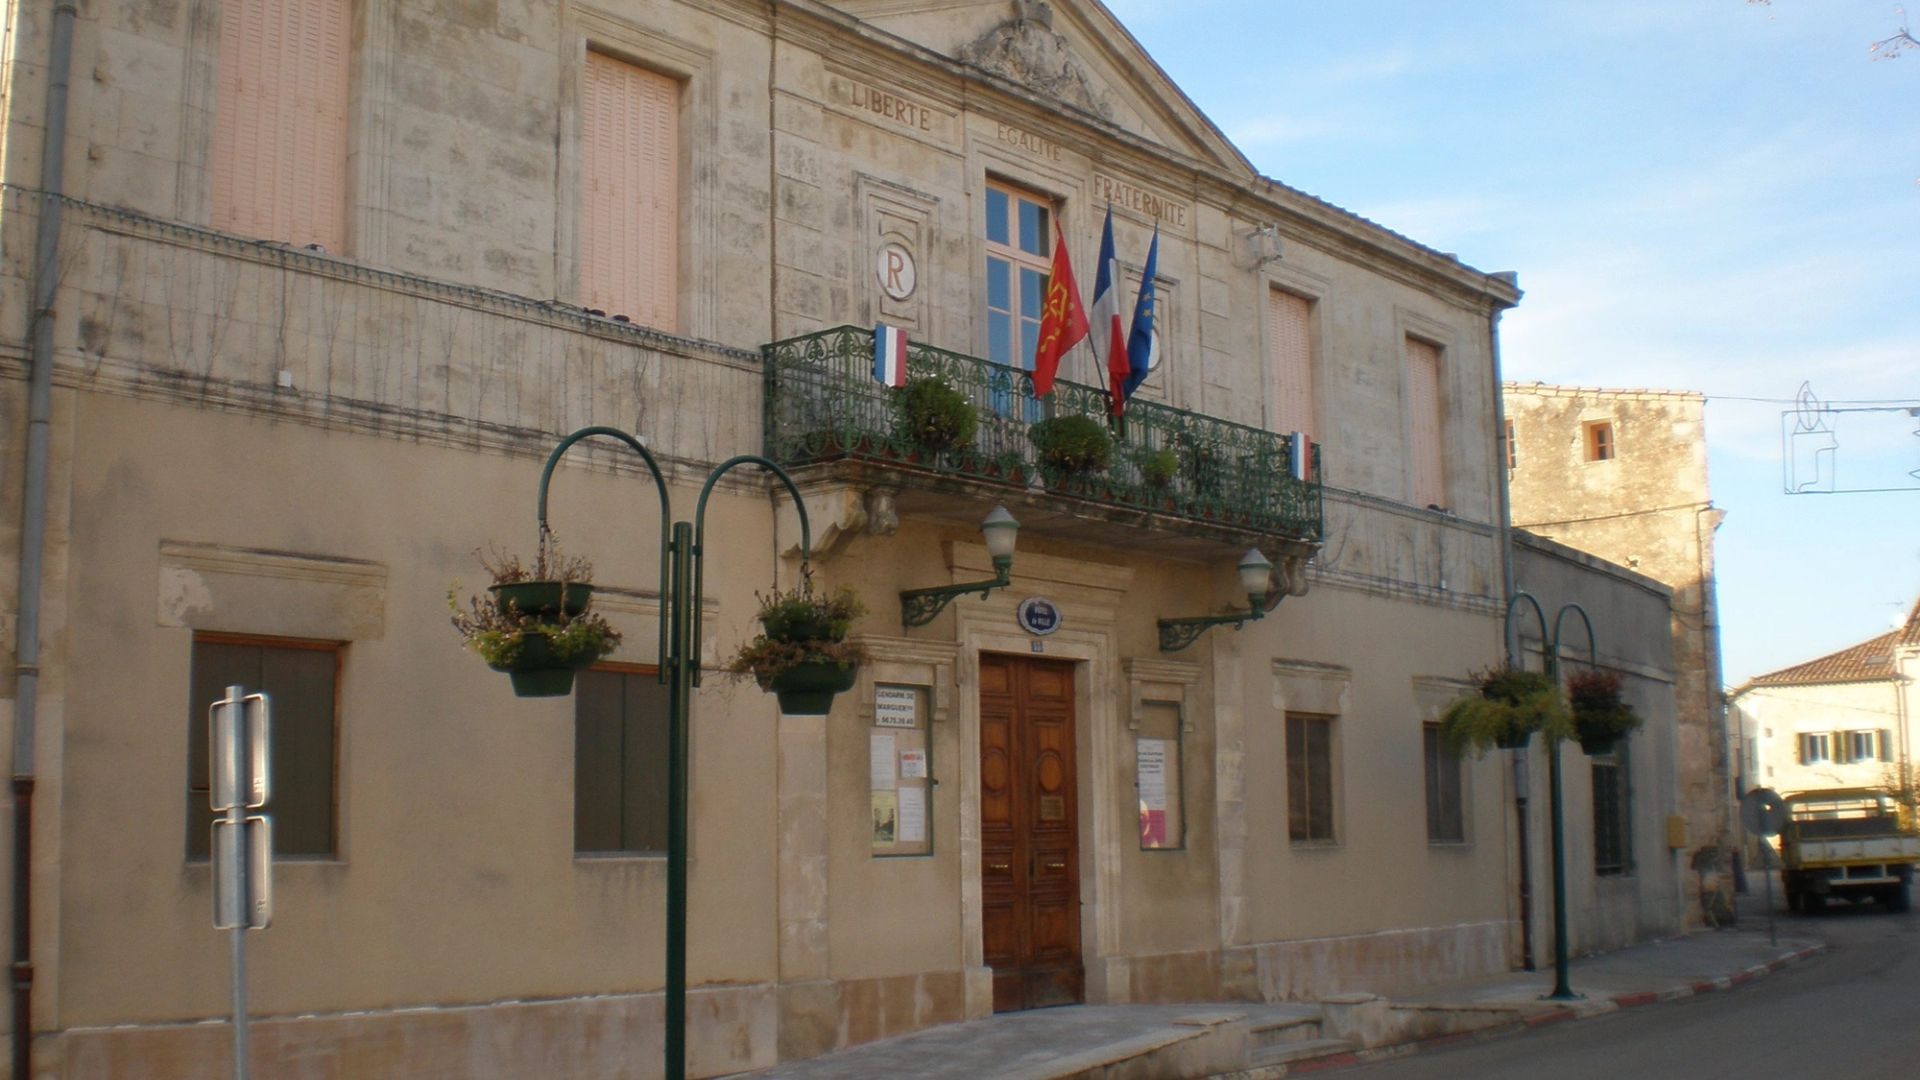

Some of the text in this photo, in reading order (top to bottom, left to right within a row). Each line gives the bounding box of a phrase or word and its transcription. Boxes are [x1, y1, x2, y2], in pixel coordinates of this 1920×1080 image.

[852, 82, 930, 131] LIBERTE
[997, 121, 1061, 161] EGALITE
[886, 250, 905, 292] R
